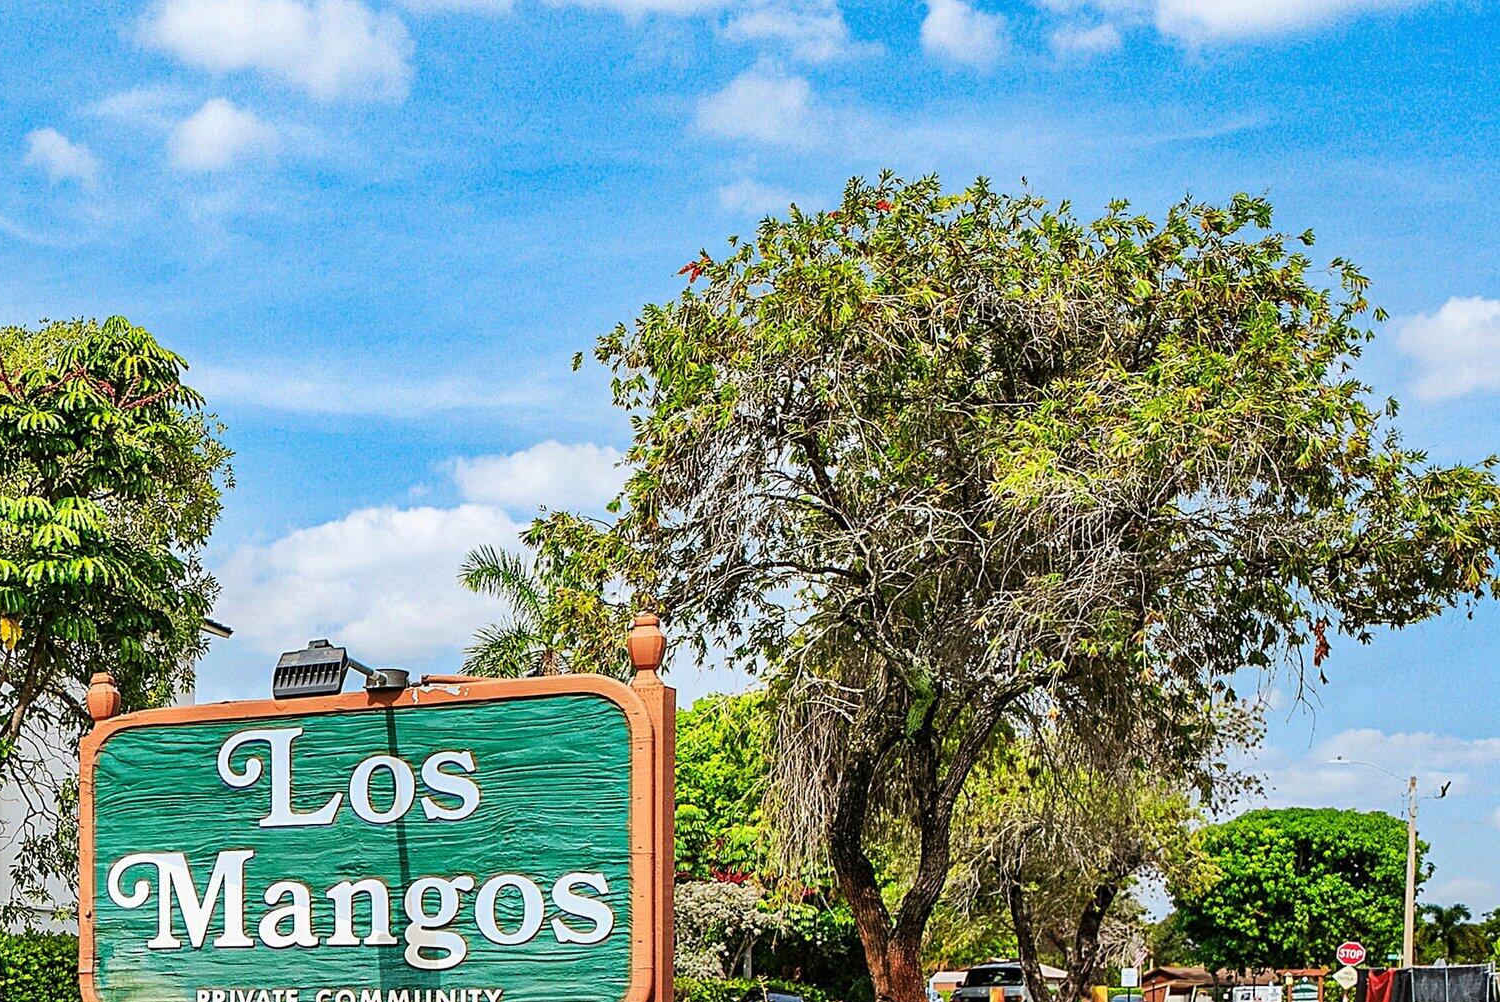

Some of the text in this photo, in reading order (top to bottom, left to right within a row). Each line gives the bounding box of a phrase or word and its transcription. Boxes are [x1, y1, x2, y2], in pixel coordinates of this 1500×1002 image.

[217, 727, 481, 828] Los
[106, 849, 615, 971] Mangos
[1339, 948, 1363, 959] STOP
